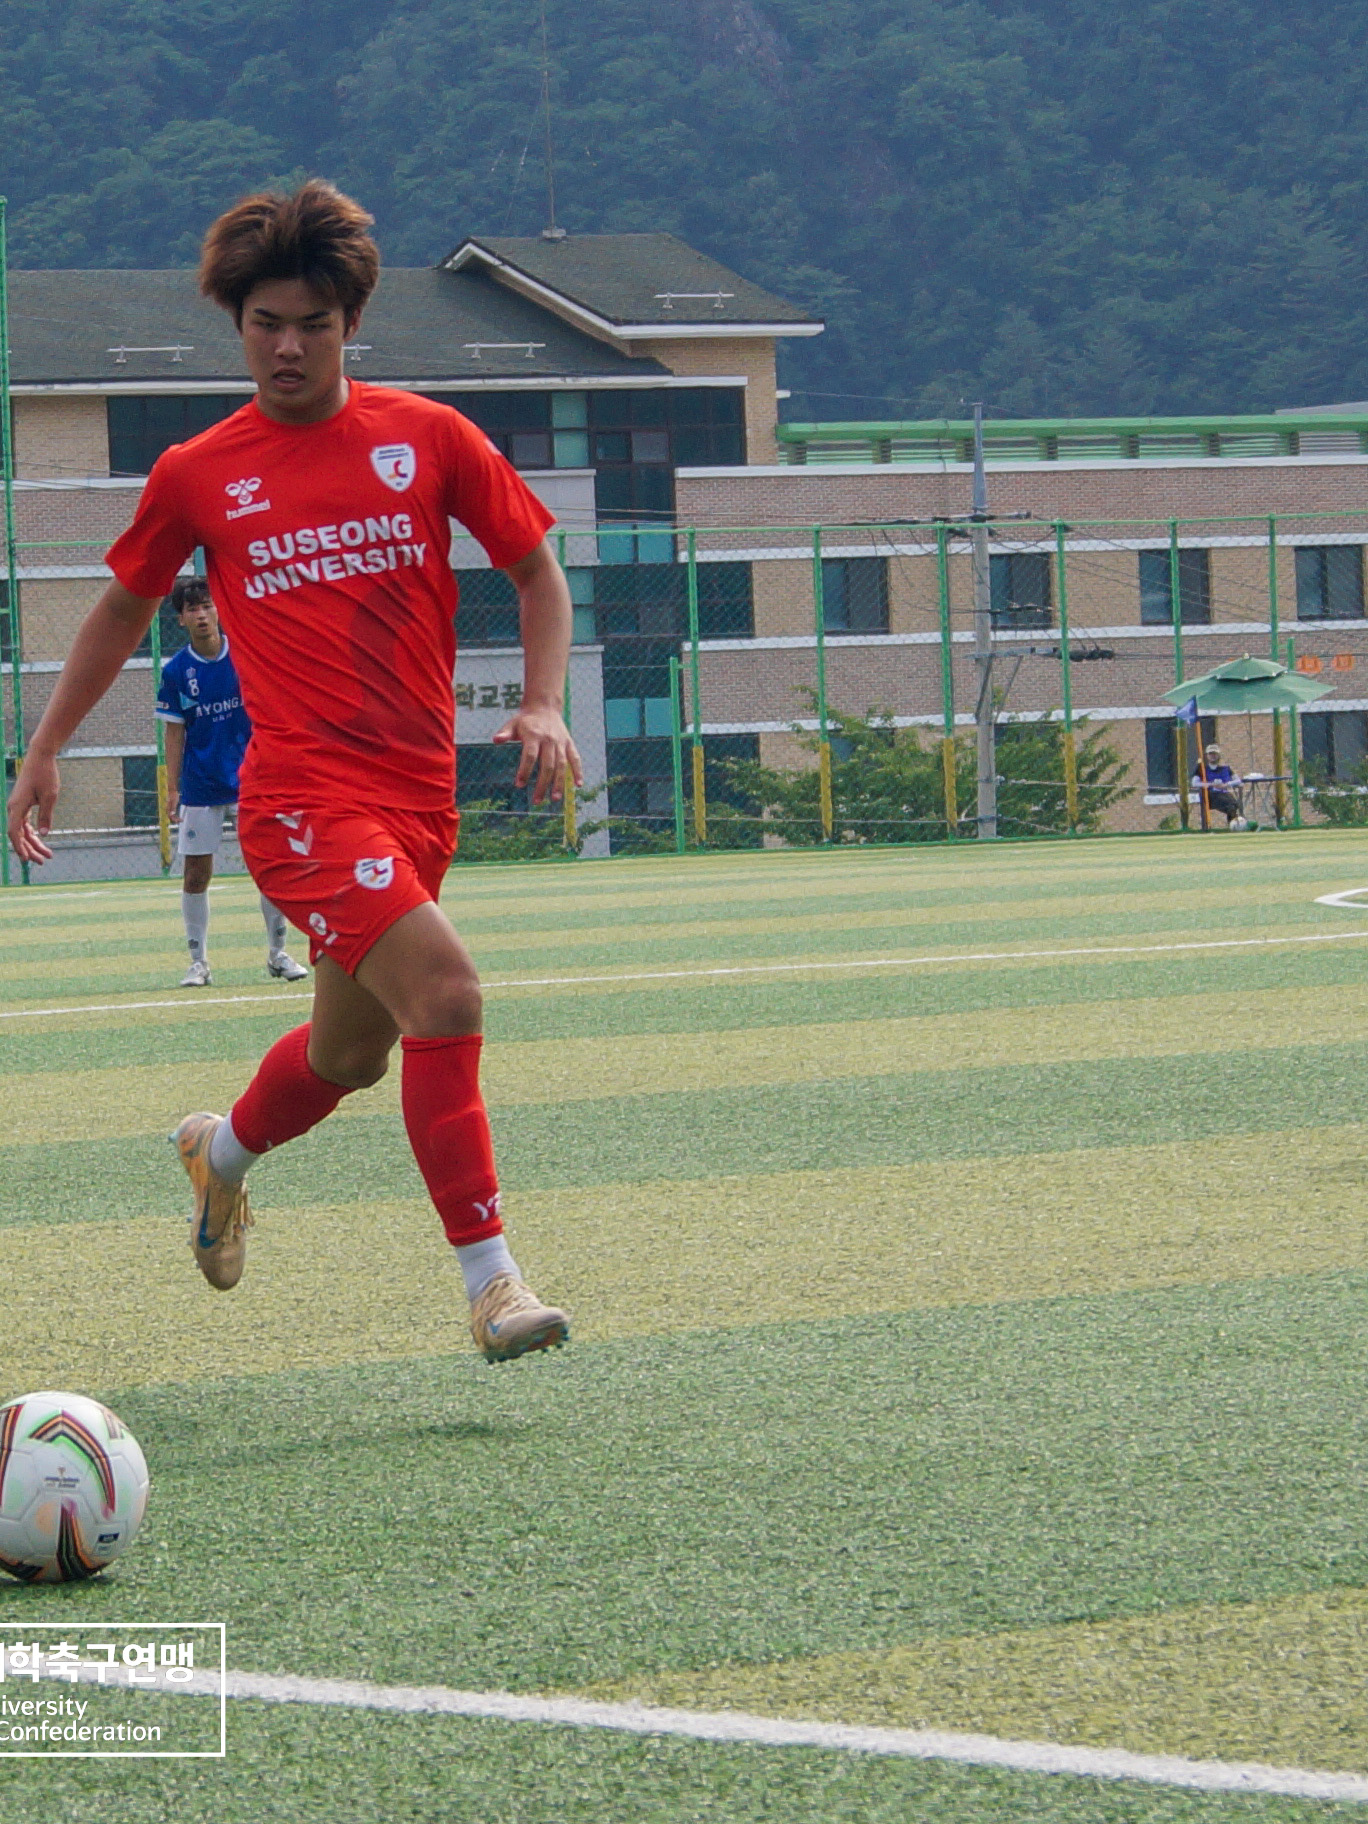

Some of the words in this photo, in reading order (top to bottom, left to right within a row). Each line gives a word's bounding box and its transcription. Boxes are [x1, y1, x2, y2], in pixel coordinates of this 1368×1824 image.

[248, 513, 413, 567] SUSEONG
[243, 542, 427, 599] UNIVERSITY
[188, 678, 200, 696] 8
